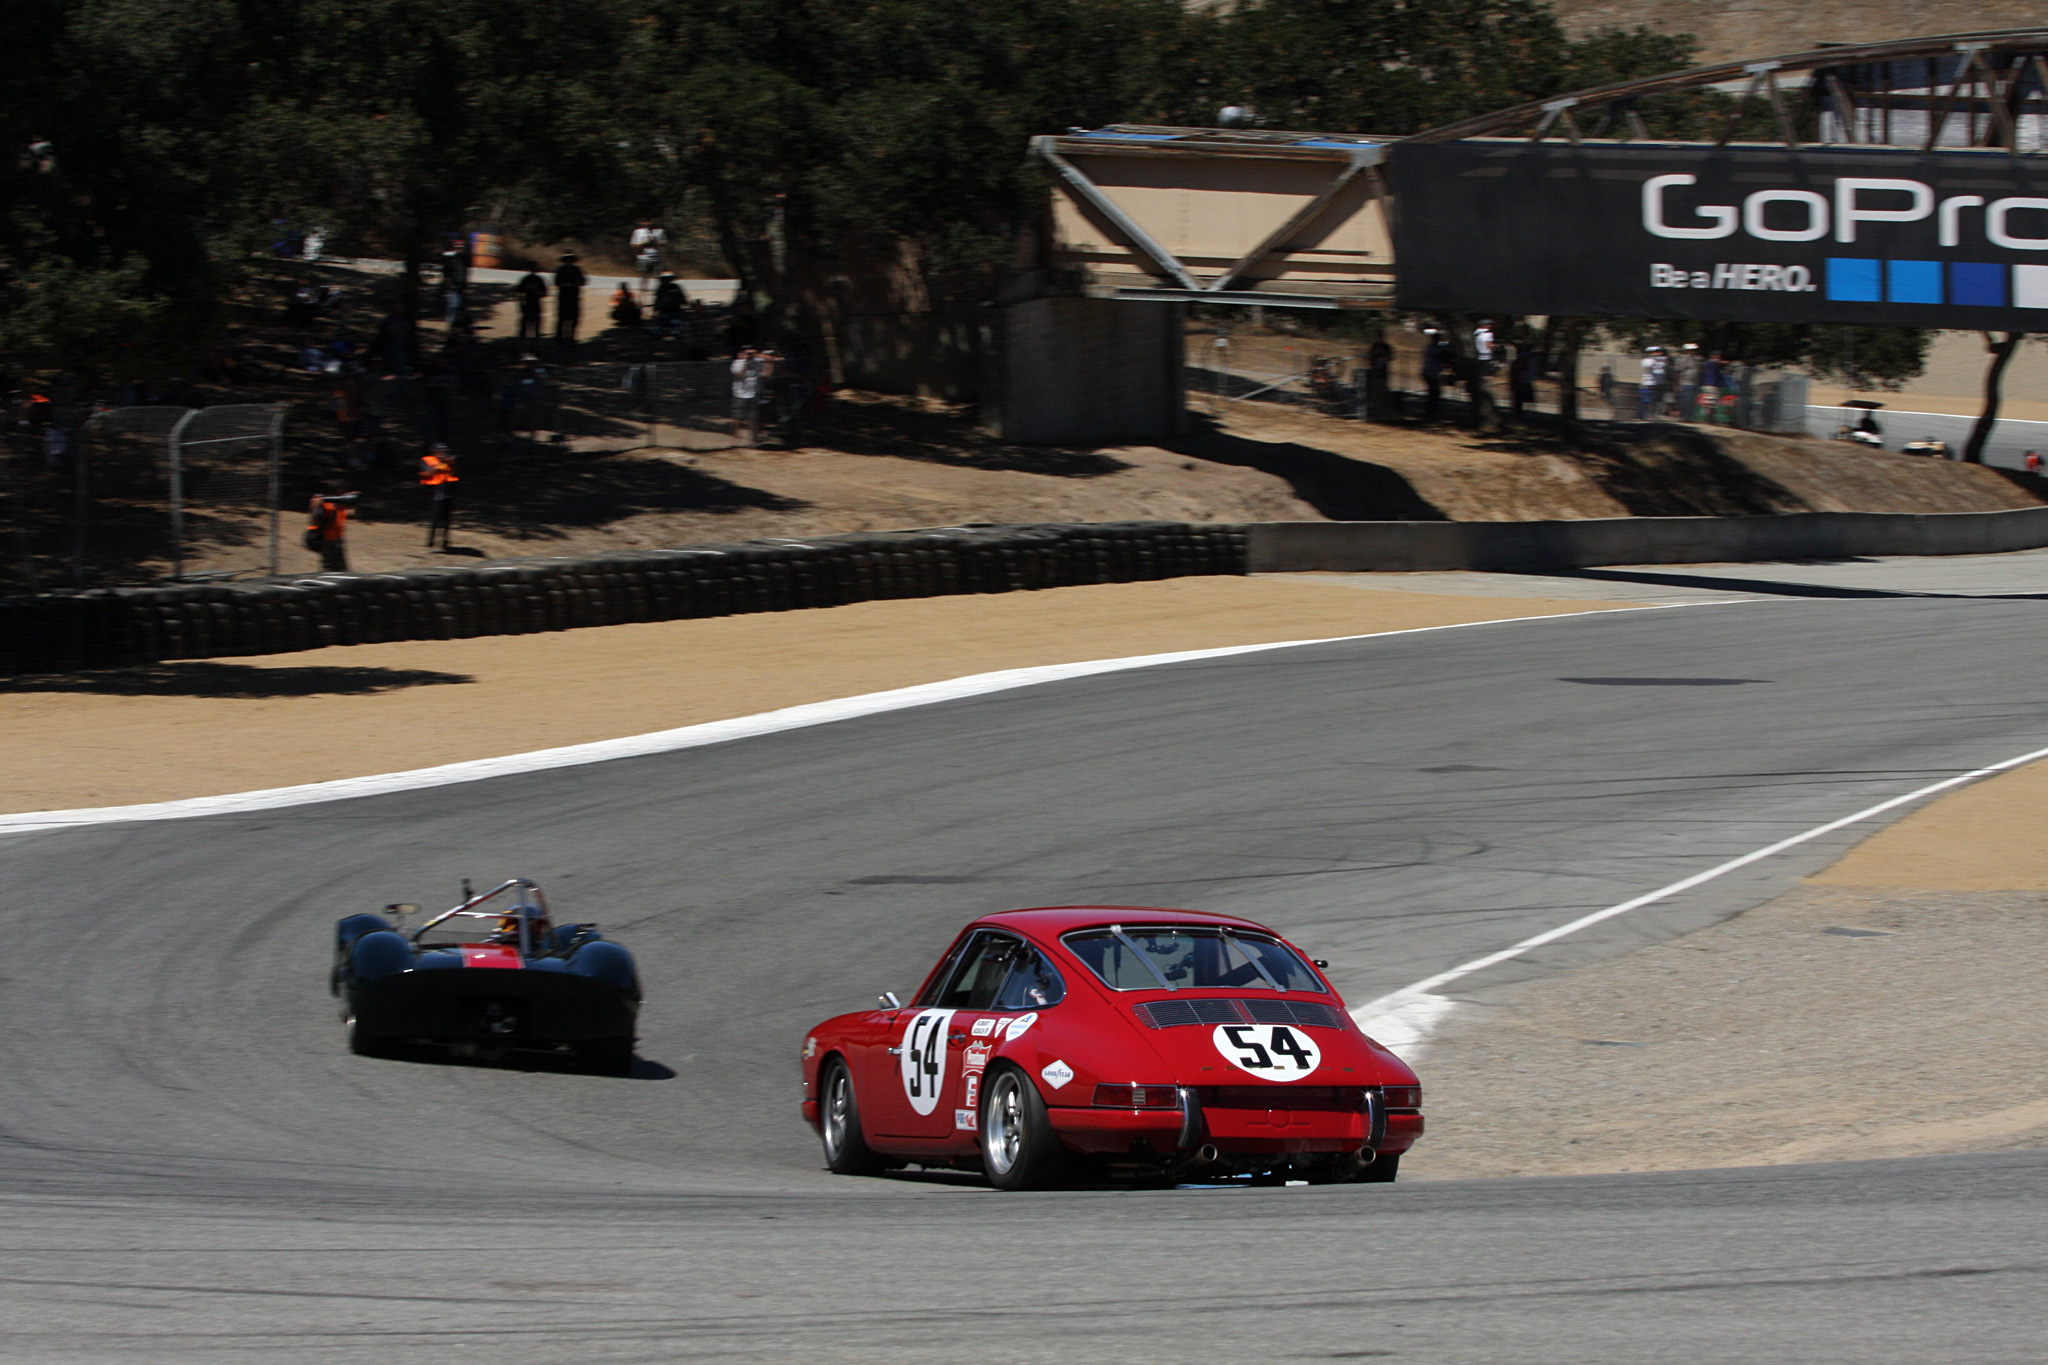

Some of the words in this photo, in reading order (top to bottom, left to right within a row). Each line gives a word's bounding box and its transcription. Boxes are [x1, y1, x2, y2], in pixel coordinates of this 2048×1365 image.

[1641, 173, 2048, 250] GoPro
[1650, 262, 1689, 289] Be
[1689, 270, 1711, 289] a
[1711, 263, 1817, 292] HERO.
[909, 1015, 946, 1098] 54
[1221, 1025, 1314, 1070] 54
